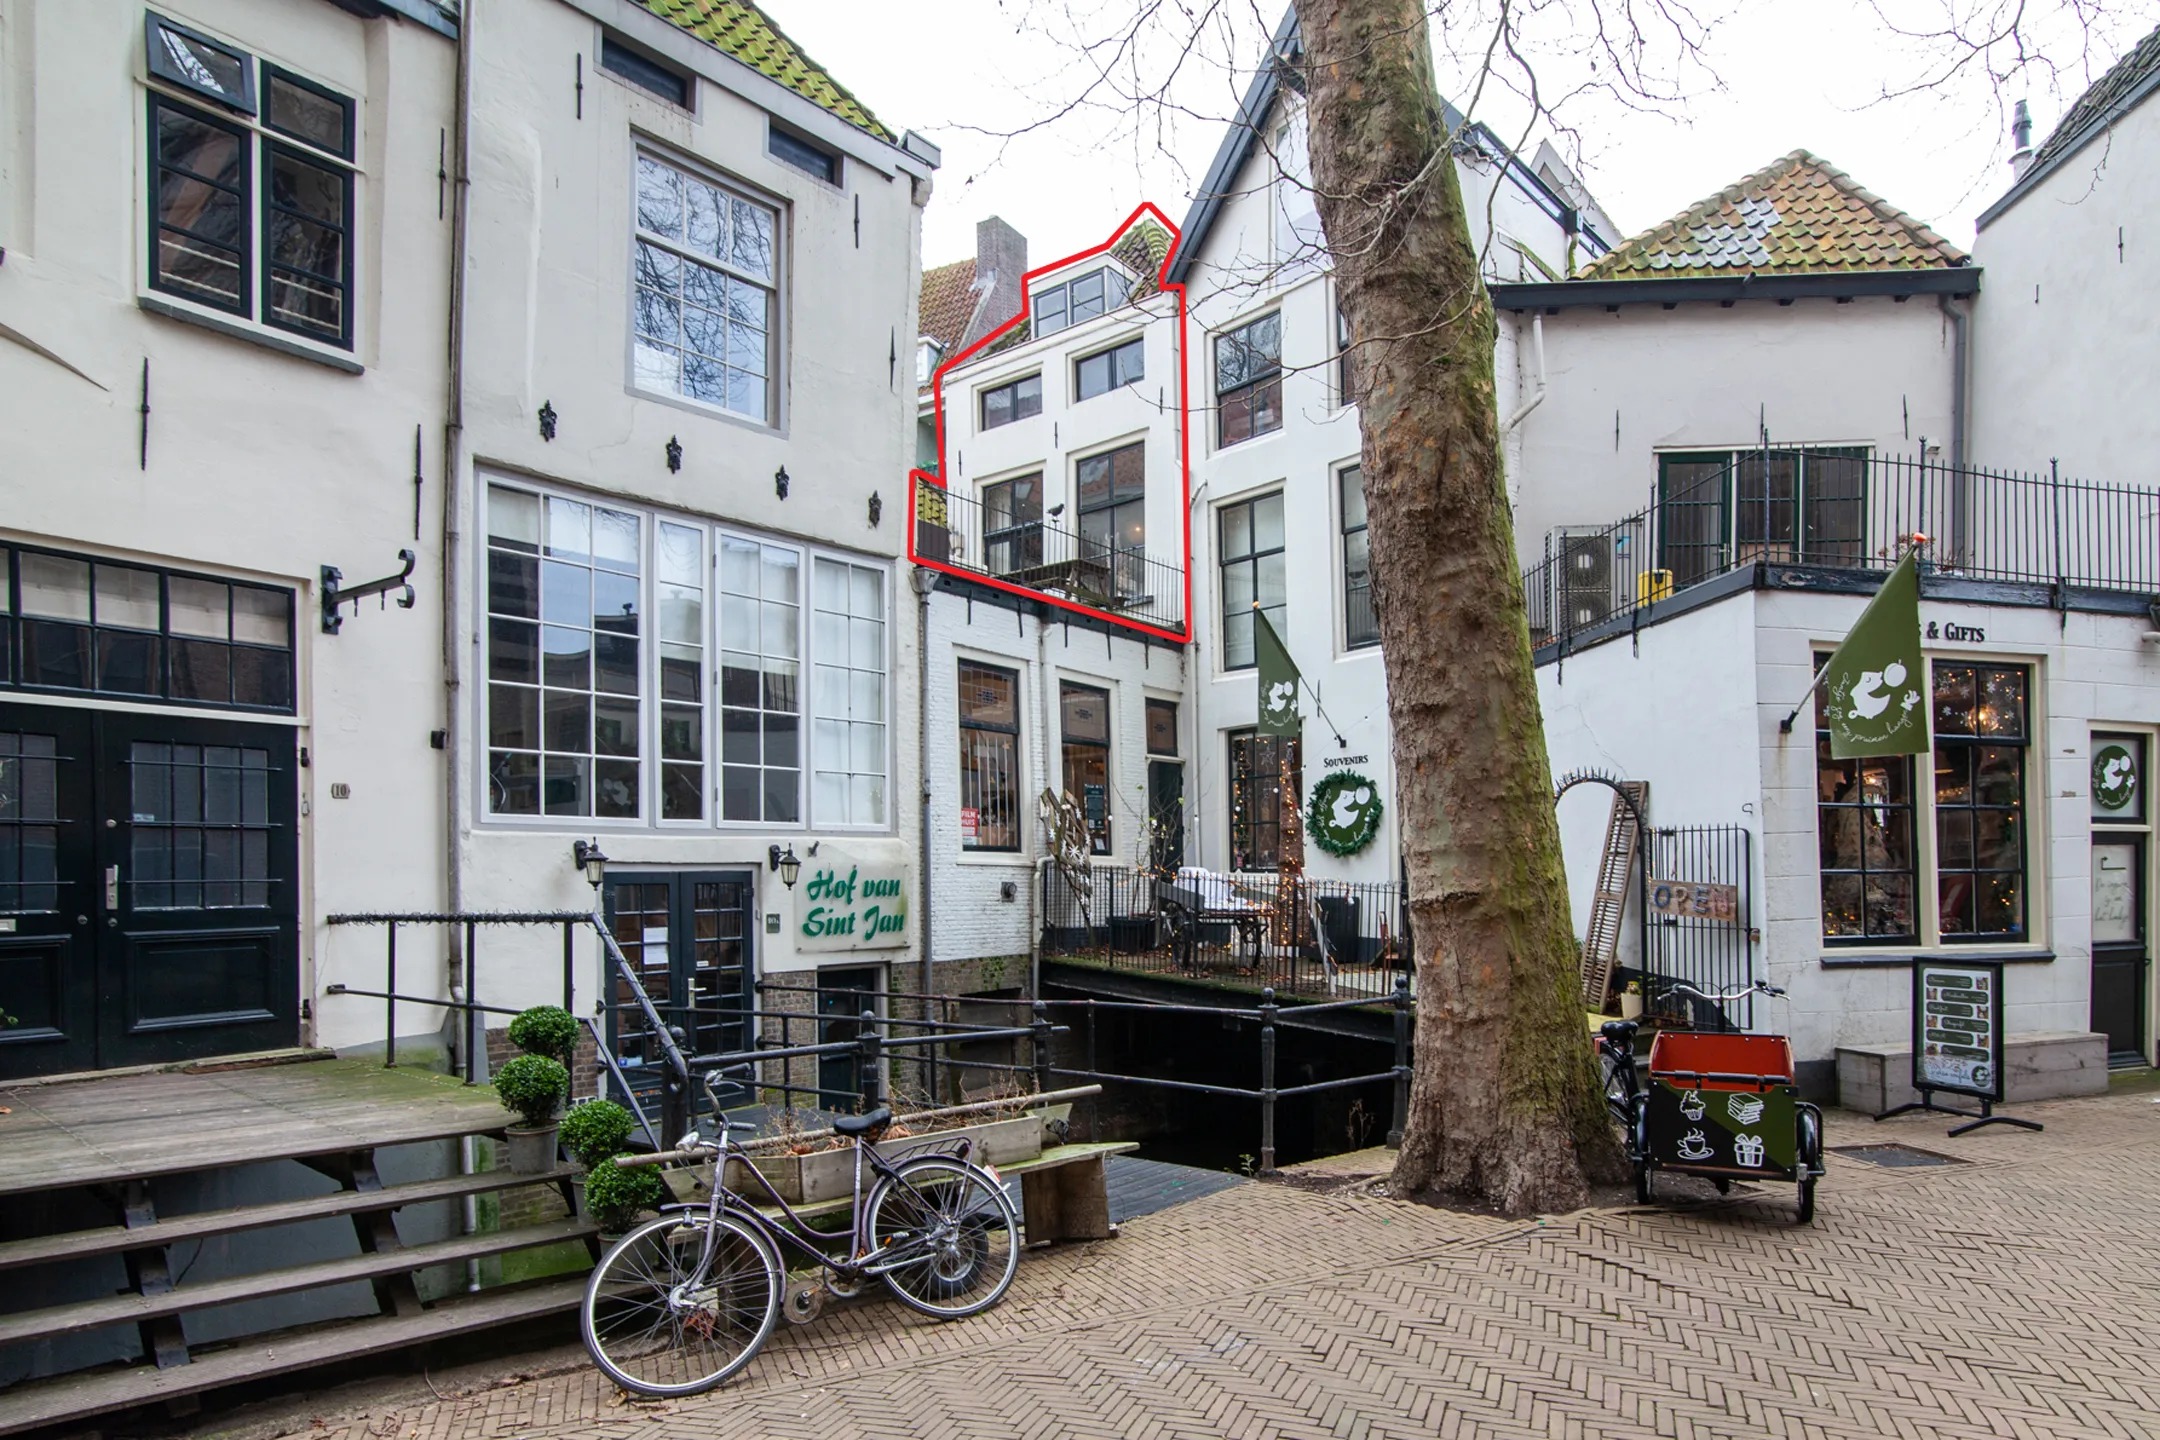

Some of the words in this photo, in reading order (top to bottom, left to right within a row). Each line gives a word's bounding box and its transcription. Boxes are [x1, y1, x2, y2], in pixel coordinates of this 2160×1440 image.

[1926, 621, 1939, 639] &
[1945, 622, 1985, 643] GIFTS
[1323, 754, 1369, 768] SOUVENIRS
[807, 869, 858, 905] Hof
[863, 879, 900, 898] van
[1653, 885, 1730, 914] OPEN
[802, 906, 856, 937] Sint
[863, 905, 905, 941] Jan
